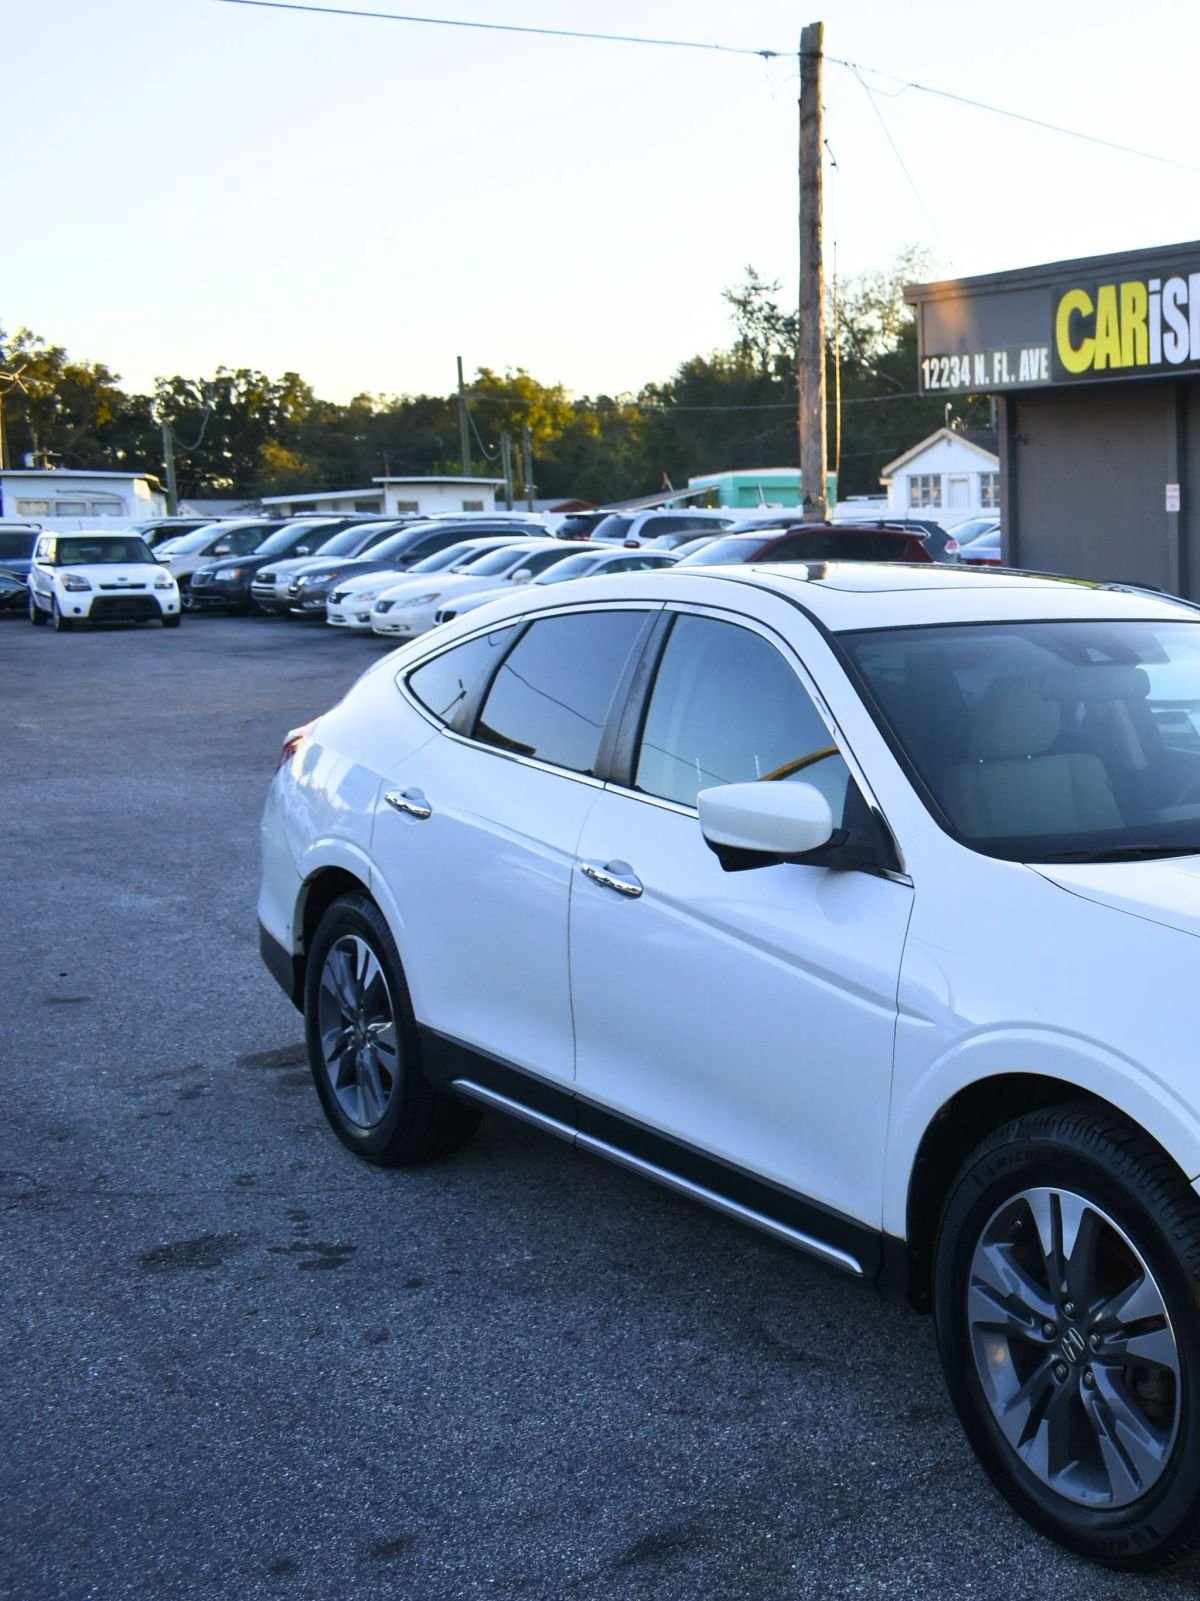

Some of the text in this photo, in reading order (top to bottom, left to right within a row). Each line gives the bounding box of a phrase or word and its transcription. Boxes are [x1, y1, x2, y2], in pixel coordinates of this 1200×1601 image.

[921, 347, 1049, 390] 12234 N. FL. AVE
